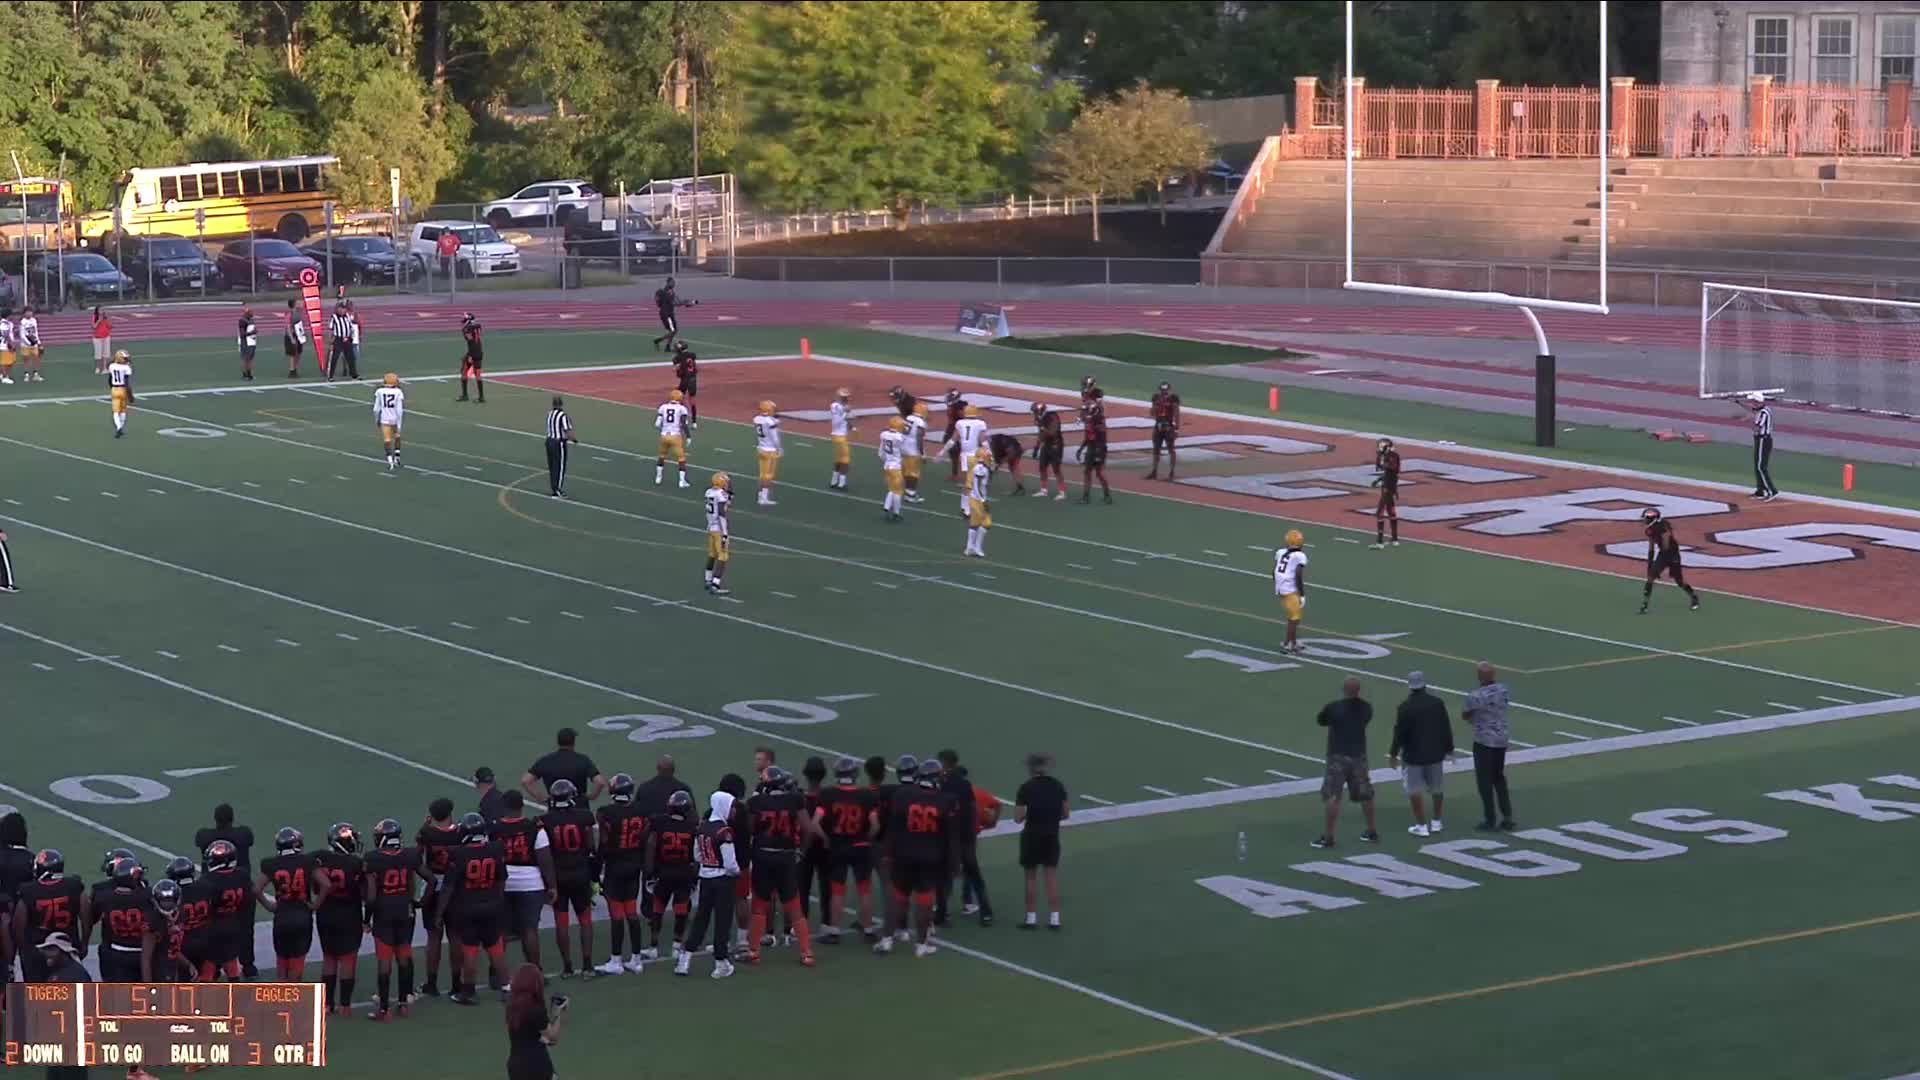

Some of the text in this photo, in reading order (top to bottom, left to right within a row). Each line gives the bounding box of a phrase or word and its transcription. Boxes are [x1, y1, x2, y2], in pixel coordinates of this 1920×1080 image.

[113, 369, 122, 384] 11
[383, 393, 396, 408] 12
[666, 408, 676, 424] 8
[964, 425, 971, 441] 1
[1277, 552, 1290, 574] 5
[586, 699, 840, 743] 20
[907, 803, 940, 833] 66
[552, 822, 583, 852] 10
[1194, 807, 1791, 919] ANGUS
[35, 895, 73, 929] 75
